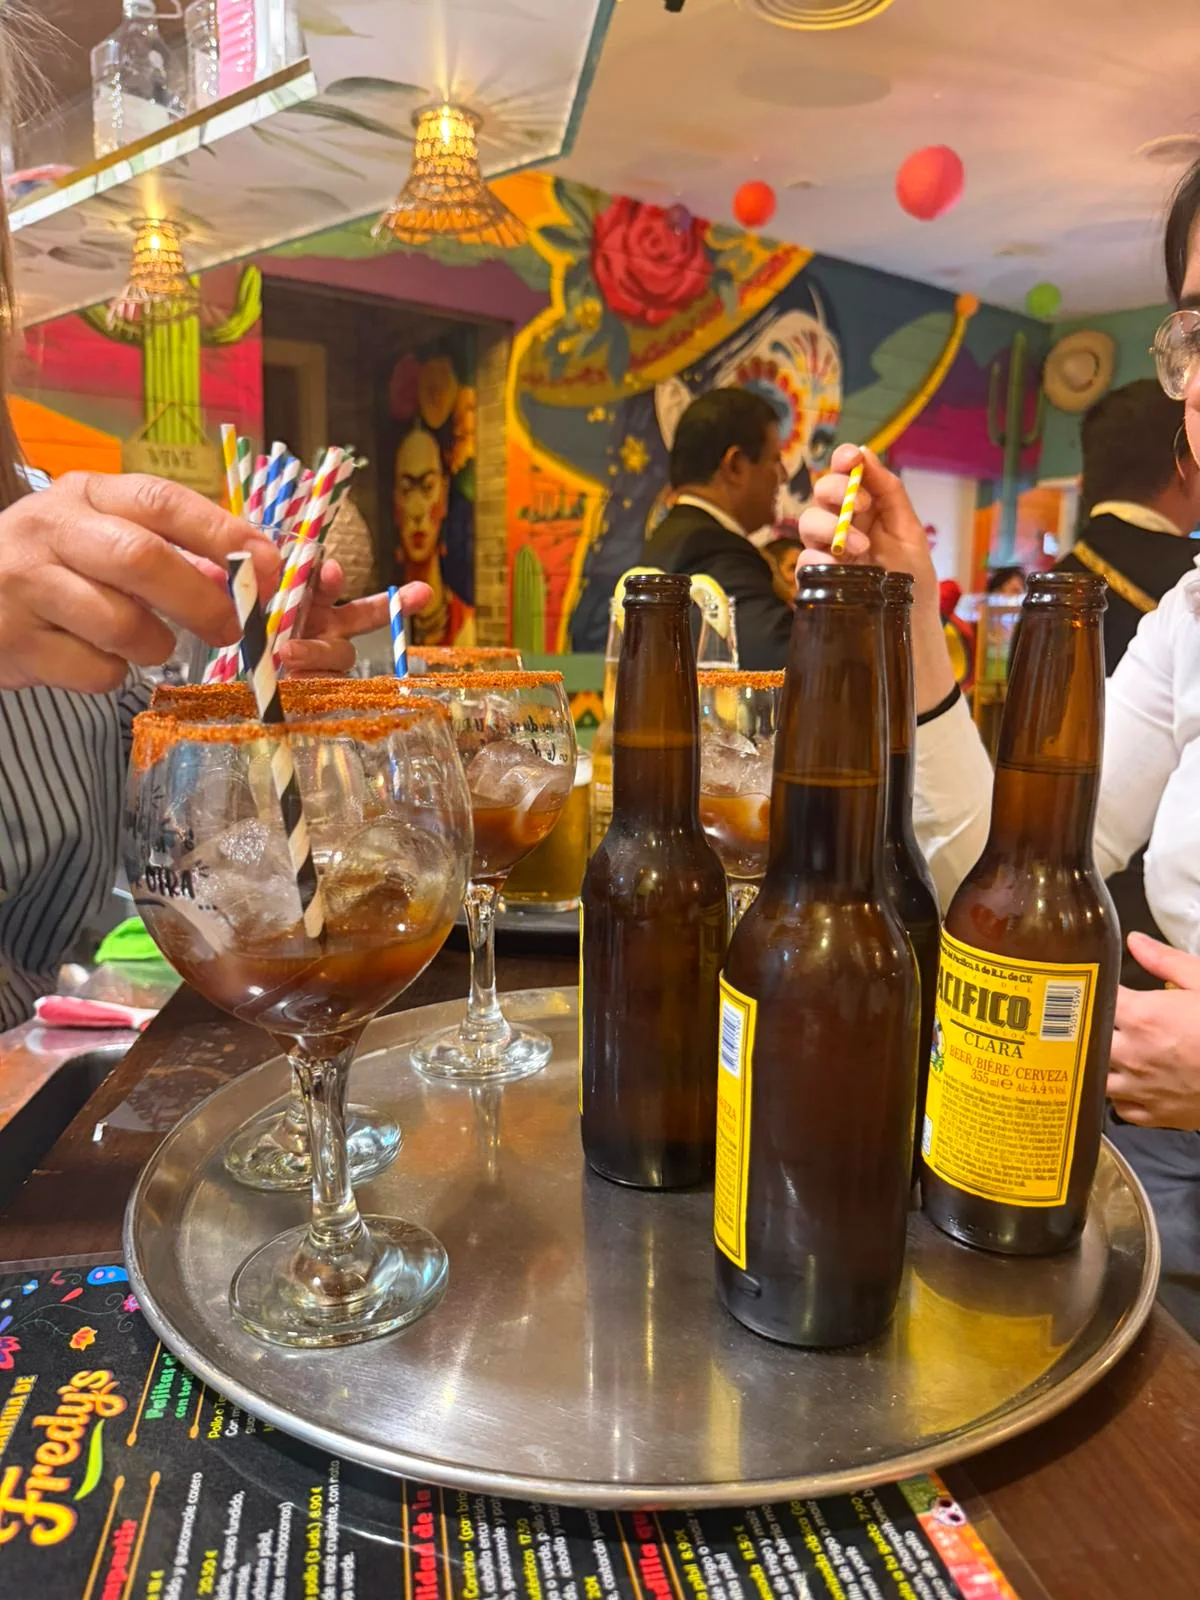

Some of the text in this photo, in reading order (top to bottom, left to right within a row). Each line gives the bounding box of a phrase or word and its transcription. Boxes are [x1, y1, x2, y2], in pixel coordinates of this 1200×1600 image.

[938, 965, 1032, 1031] ACIFICO
[964, 1032, 1023, 1059] CLARA
[971, 1067, 989, 1085] 355
[0, 1374, 39, 1455] ANTINA DE
[175, 1398, 189, 1418] con
[208, 1415, 224, 1439] Pollo
[224, 1418, 240, 1438] Con
[0, 1369, 128, 1546] Fredy's
[328, 1484, 341, 1503] con
[174, 1504, 198, 1566] guacamole
[187, 1471, 203, 1504] casero
[223, 1490, 246, 1536] fundido,
[411, 1511, 435, 1539] de
[222, 1535, 239, 1570] queso
[492, 1526, 518, 1592] guacamole
[553, 1536, 574, 1578] cebolla
[824, 1536, 846, 1566] trigo
[904, 1530, 930, 1560] gallo
[413, 1541, 440, 1600] lidad
[478, 1550, 497, 1594] cebolla
[701, 1556, 722, 1586] trigo
[762, 1546, 782, 1576] trigo
[783, 1554, 799, 1572] de
